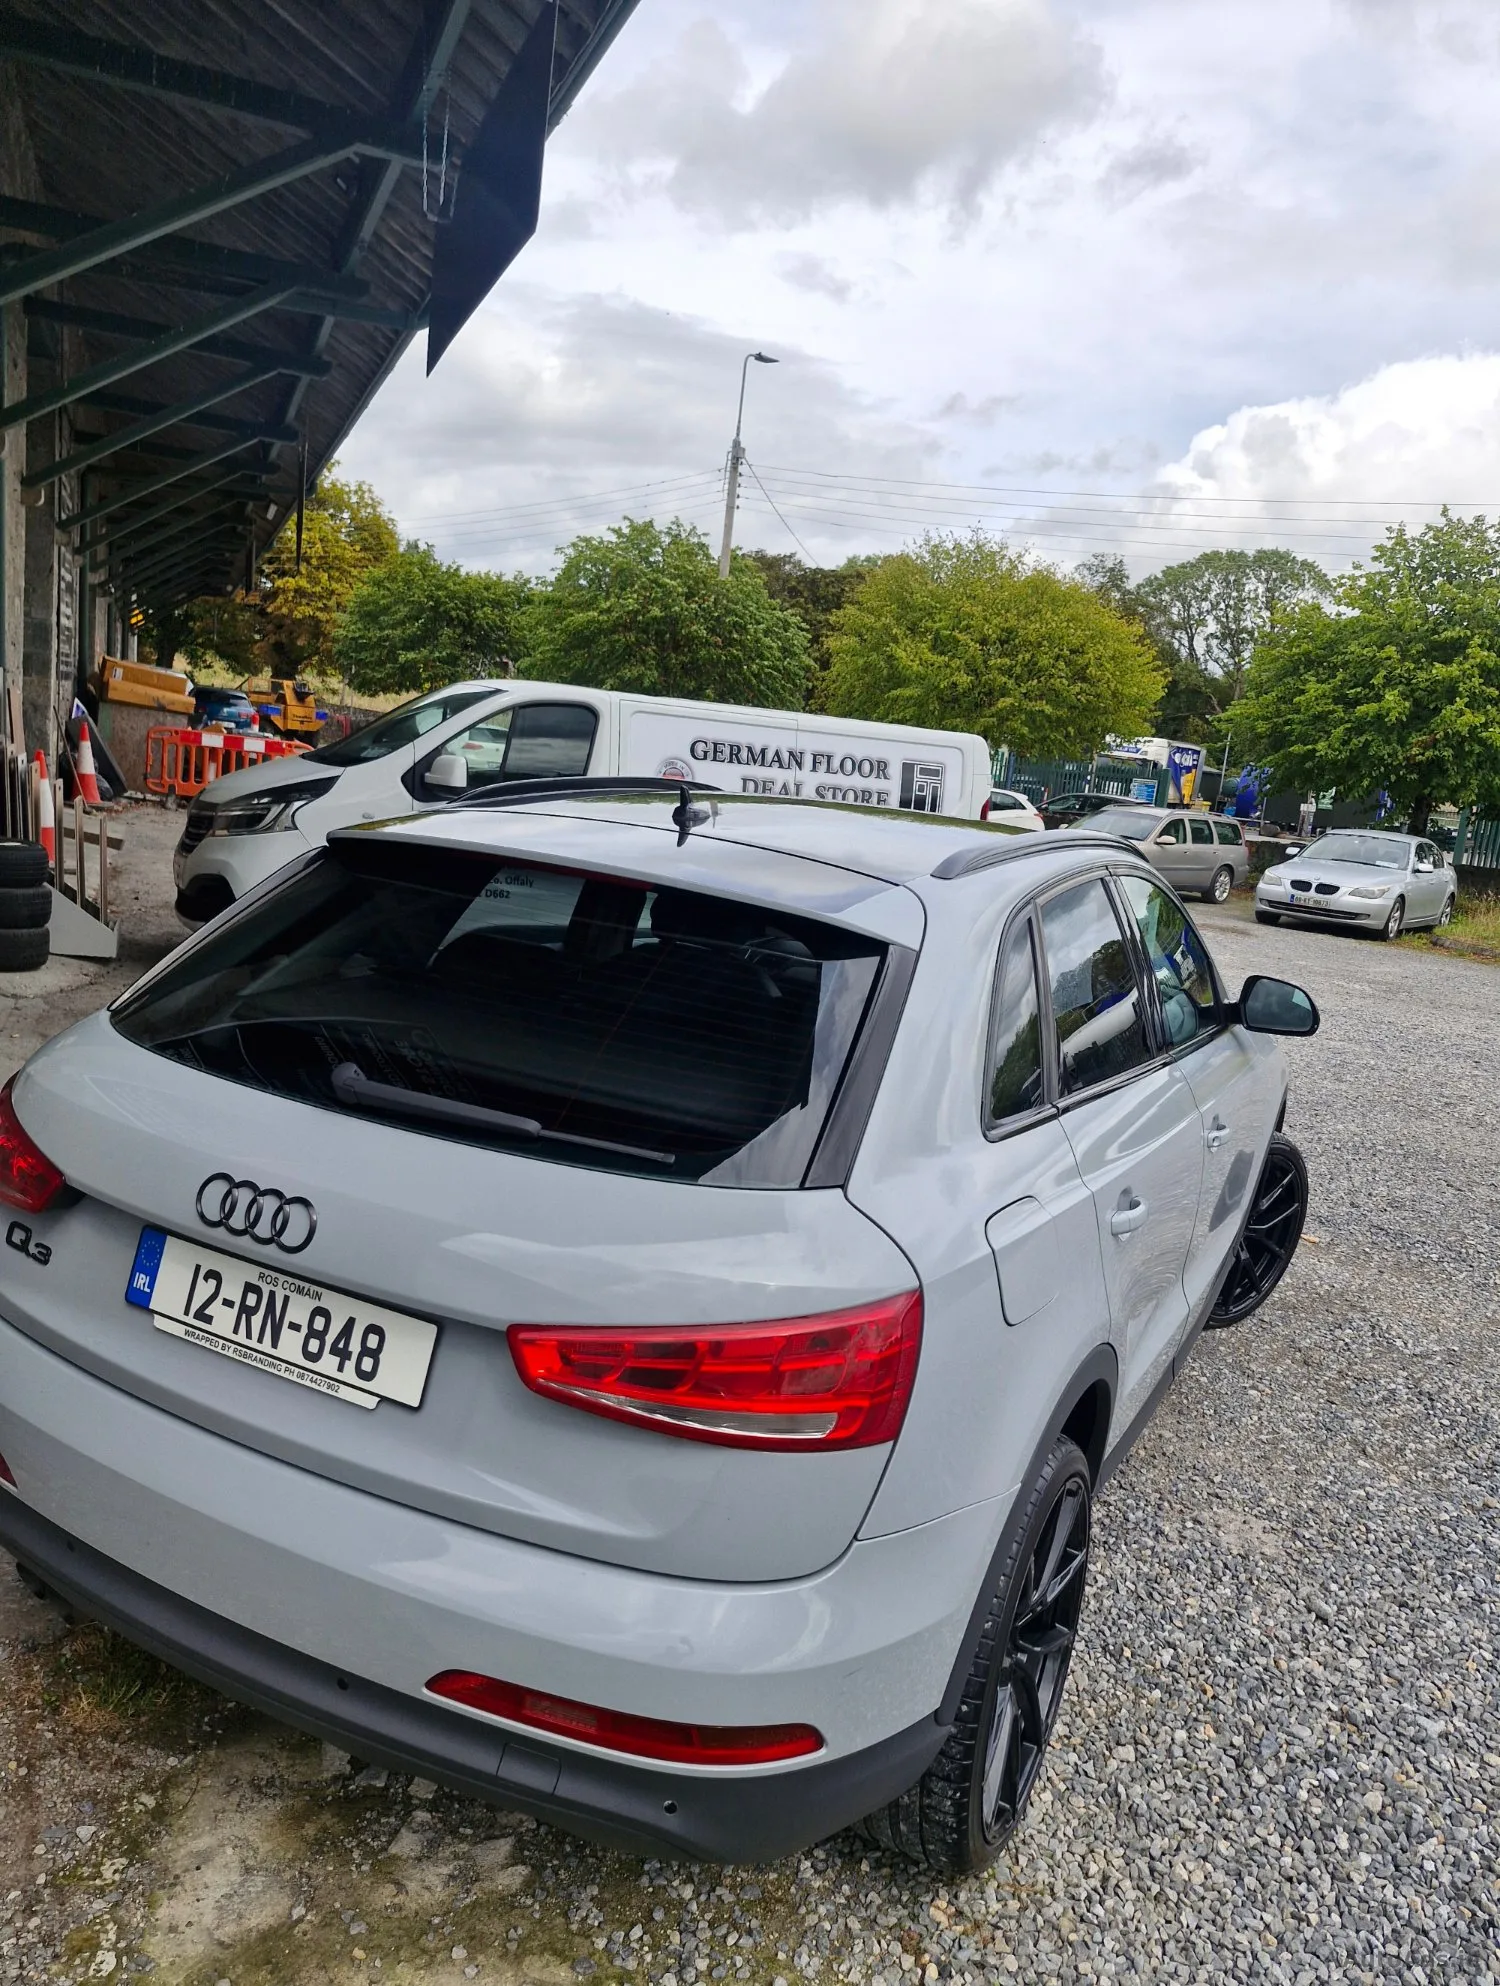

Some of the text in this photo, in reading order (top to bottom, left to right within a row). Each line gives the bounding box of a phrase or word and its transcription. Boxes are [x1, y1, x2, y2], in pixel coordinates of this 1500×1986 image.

[690, 740, 890, 780] GERMAN FLOOR
[6, 1221, 52, 1266] Q3
[133, 1272, 151, 1293] IRL
[257, 1272, 323, 1302] ROS COMÁIN
[183, 1264, 386, 1382] 12-RN-848
[184, 1328, 341, 1393] WRAPPED BY RSBRANDING PH 0874427902
